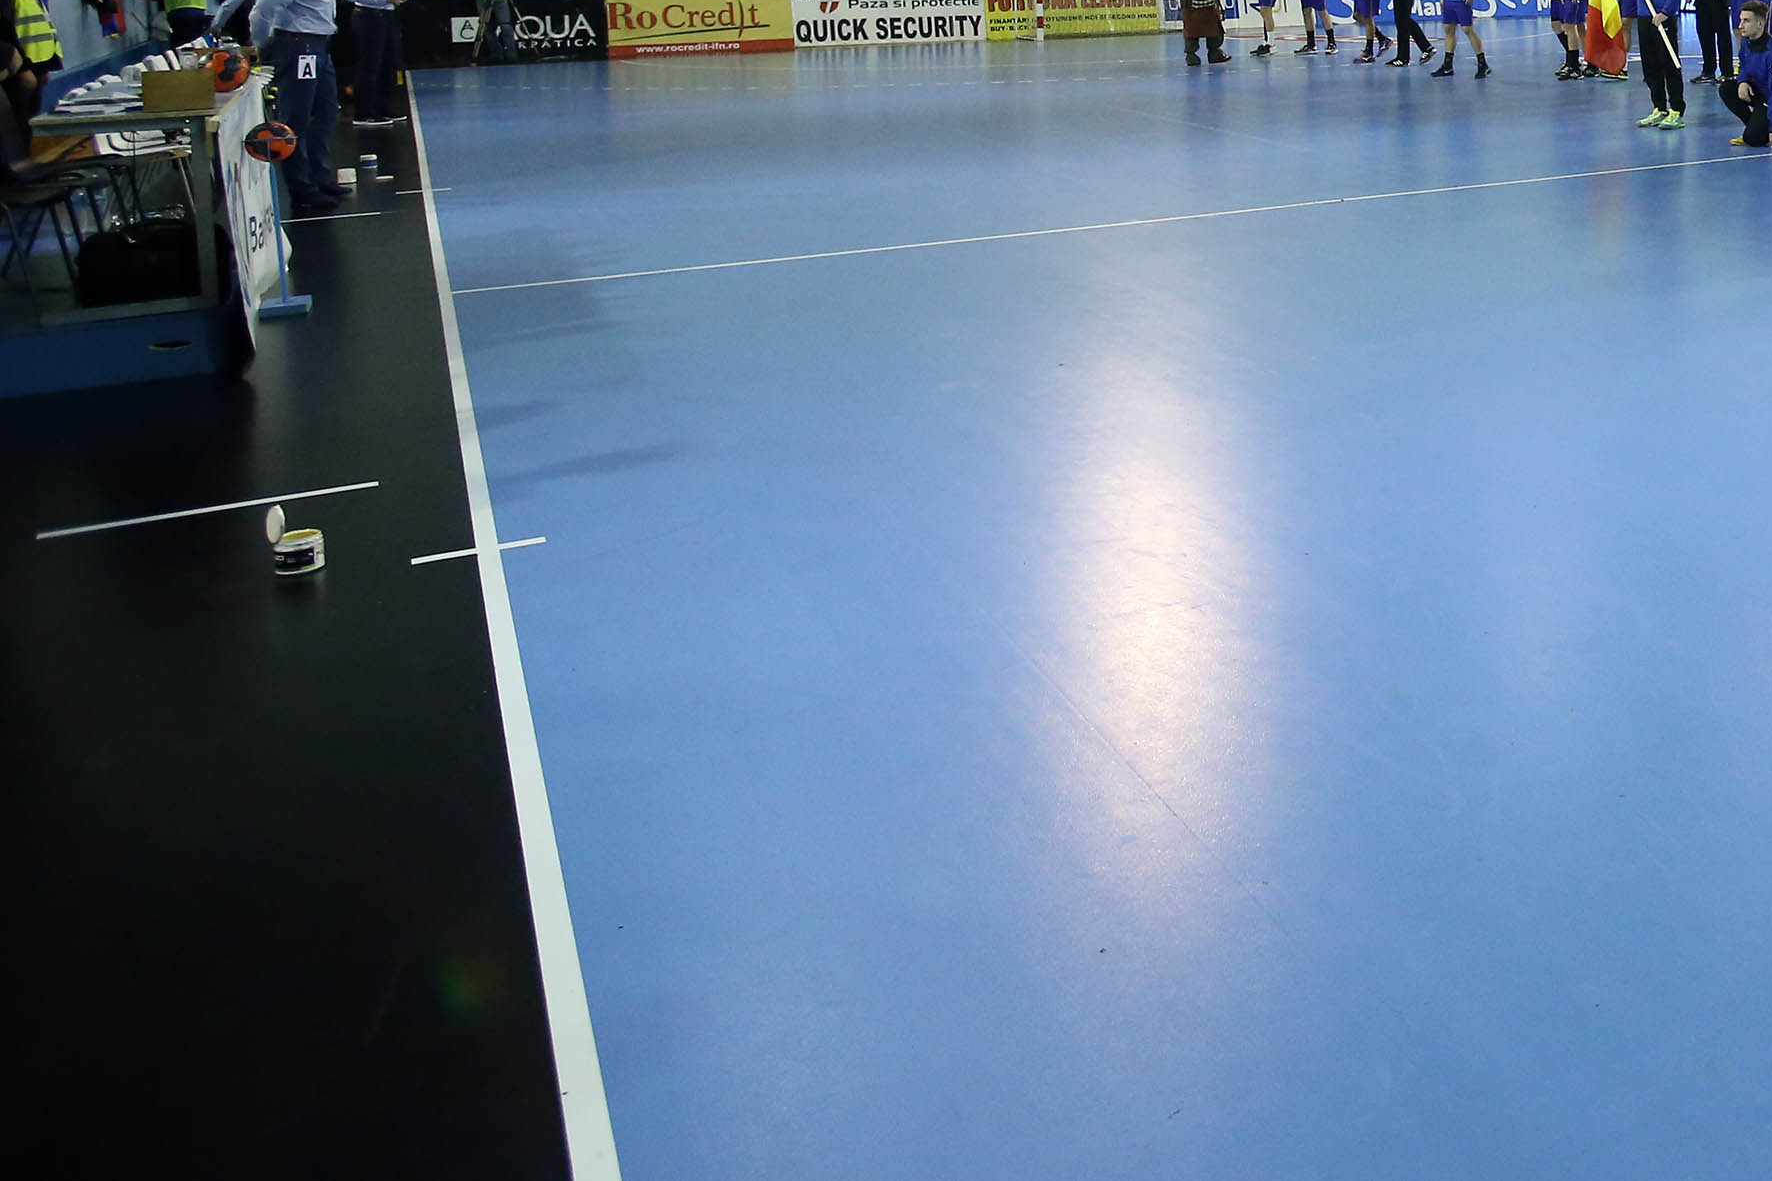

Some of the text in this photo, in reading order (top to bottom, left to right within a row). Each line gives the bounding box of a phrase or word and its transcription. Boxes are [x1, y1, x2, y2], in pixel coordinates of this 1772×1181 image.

[496, 13, 596, 40] QUA
[795, 15, 982, 43] QUICK SECURITY
[517, 38, 597, 49] RPATICA
[636, 42, 740, 54] www.rocredit-ifn.ro
[302, 62, 313, 77] A
